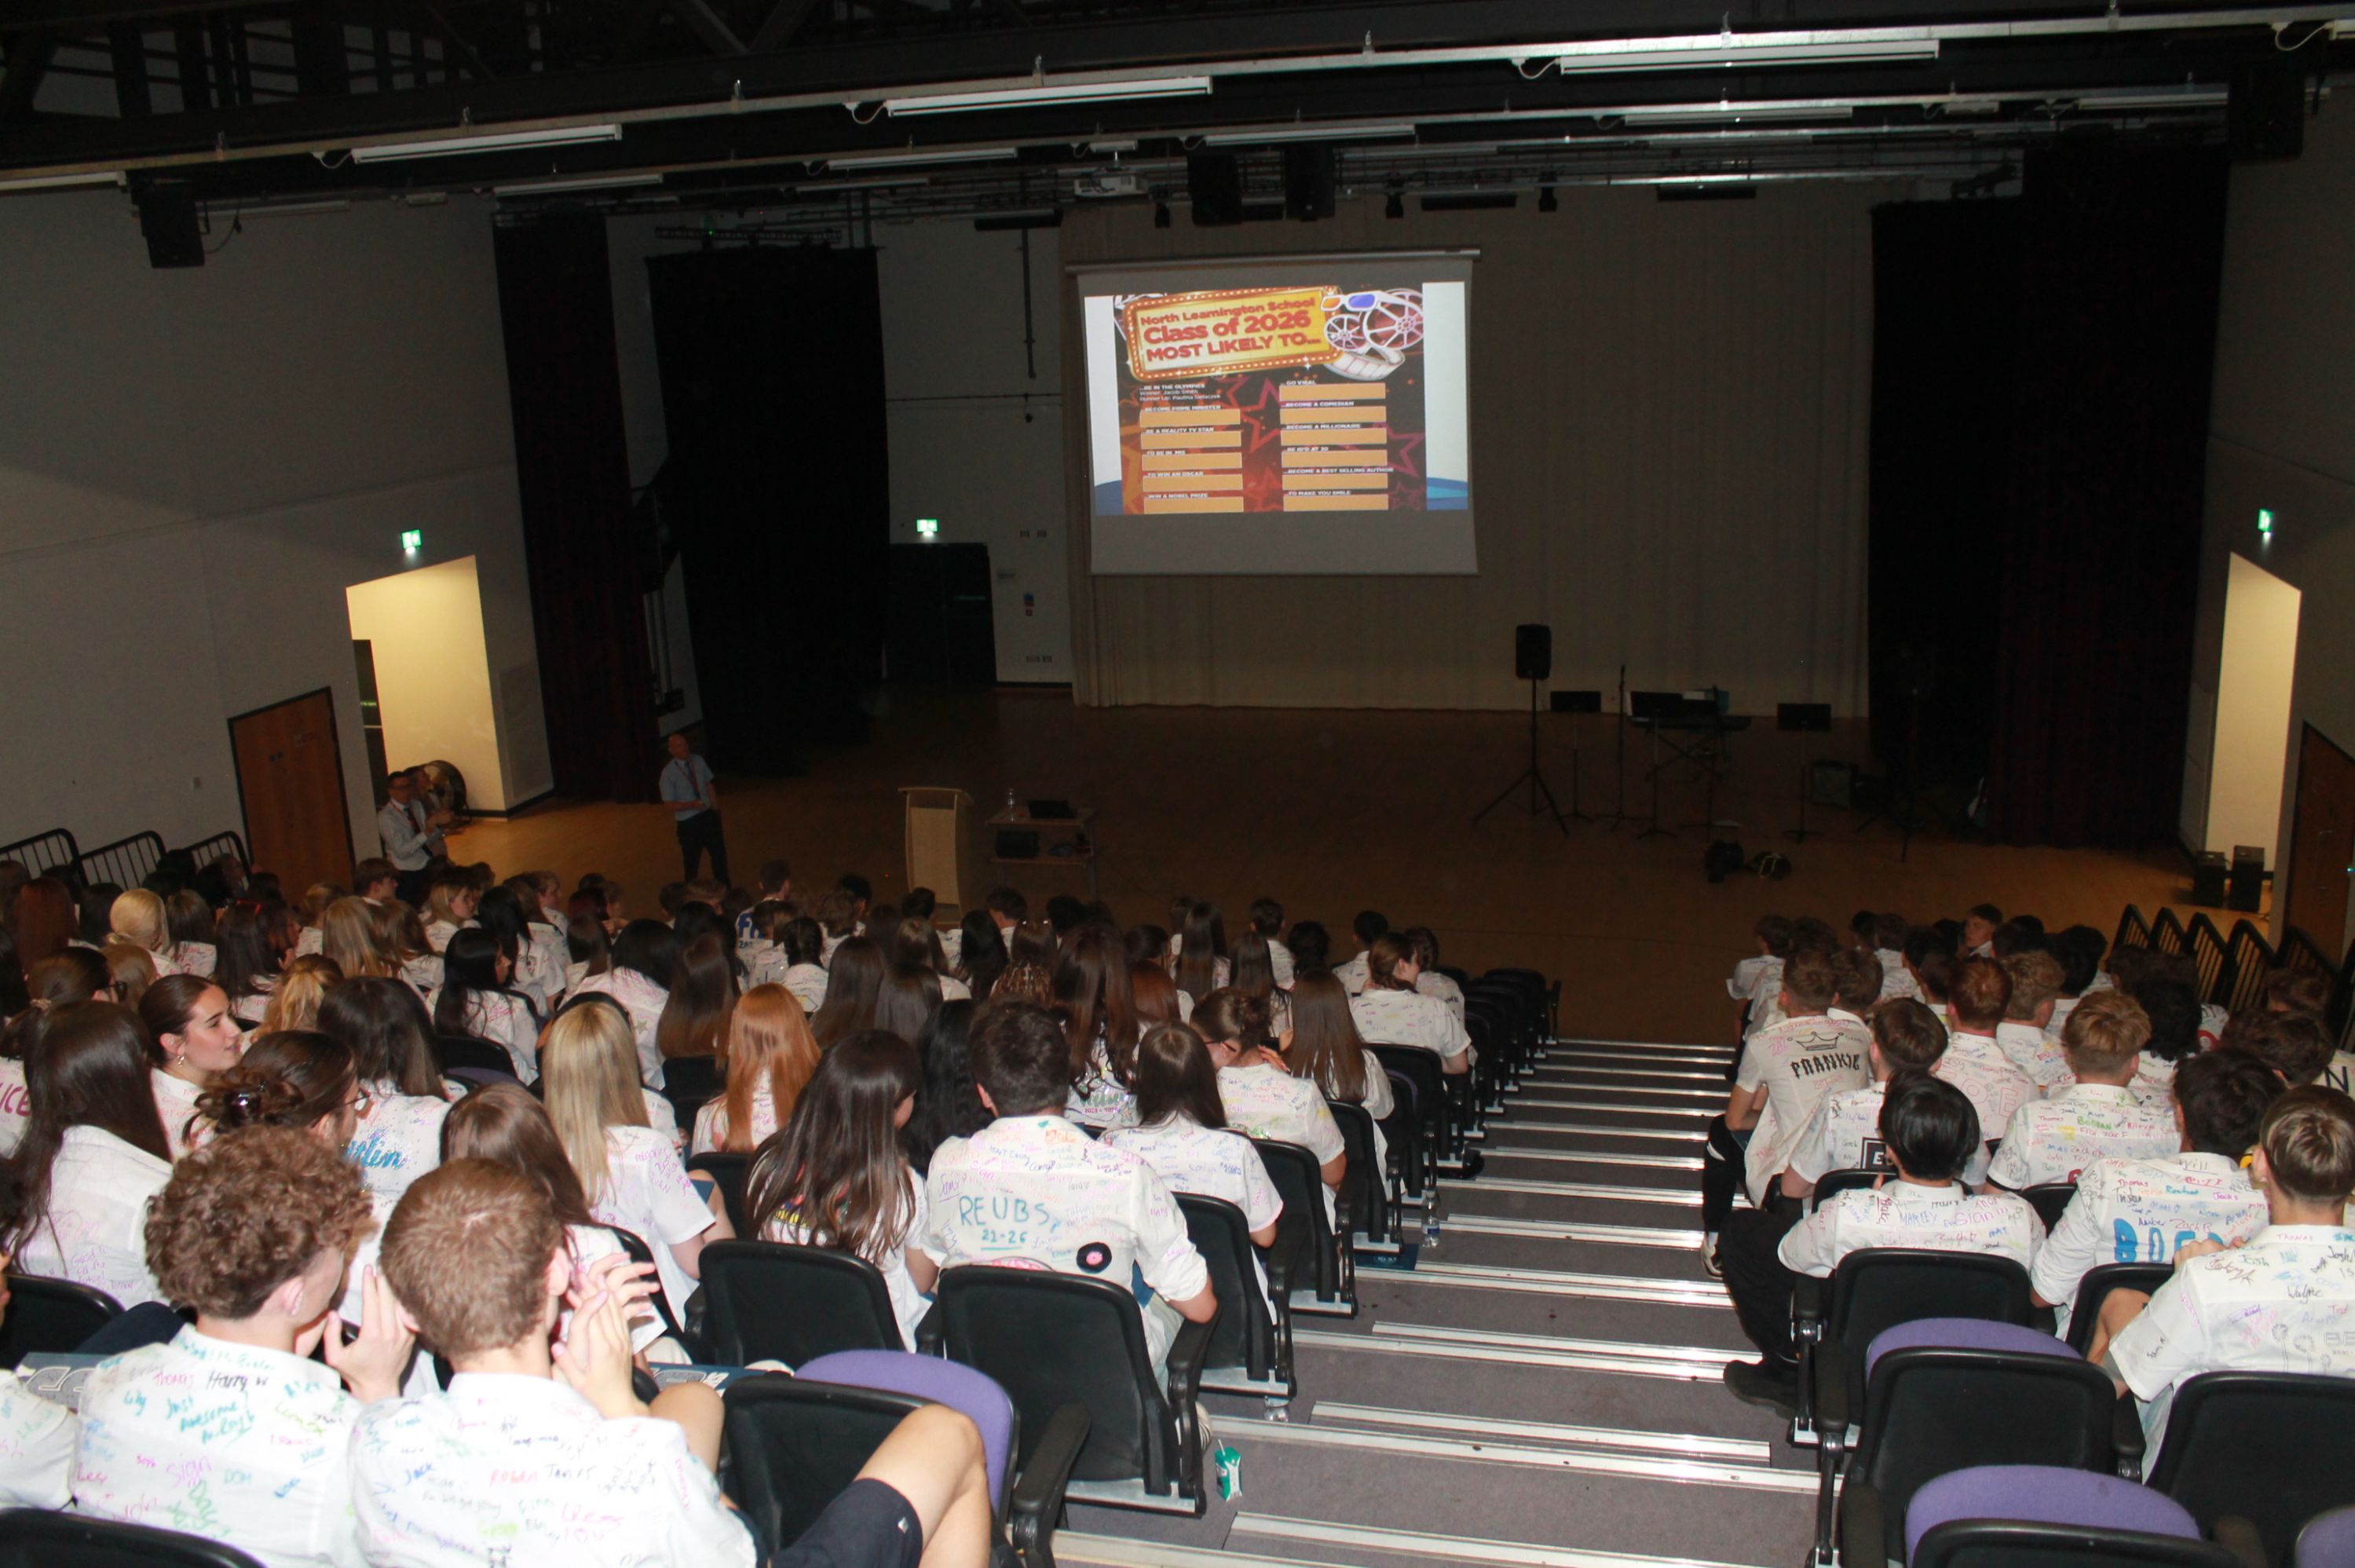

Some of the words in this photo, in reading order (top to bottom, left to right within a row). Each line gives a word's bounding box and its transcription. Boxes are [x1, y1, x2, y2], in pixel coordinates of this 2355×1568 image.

[1140, 313, 1179, 326] North
[1183, 303, 1264, 320] Leamington
[1267, 298, 1315, 311] School
[1143, 323, 1209, 344] Class
[1212, 318, 1240, 336] of
[1244, 310, 1311, 334] 2026
[1146, 343, 1202, 361] MOST
[1208, 335, 1274, 355] LIKELY
[959, 1194, 1050, 1226] REUBS
[982, 1228, 1029, 1245] 21-26
[206, 1369, 249, 1392] Harry
